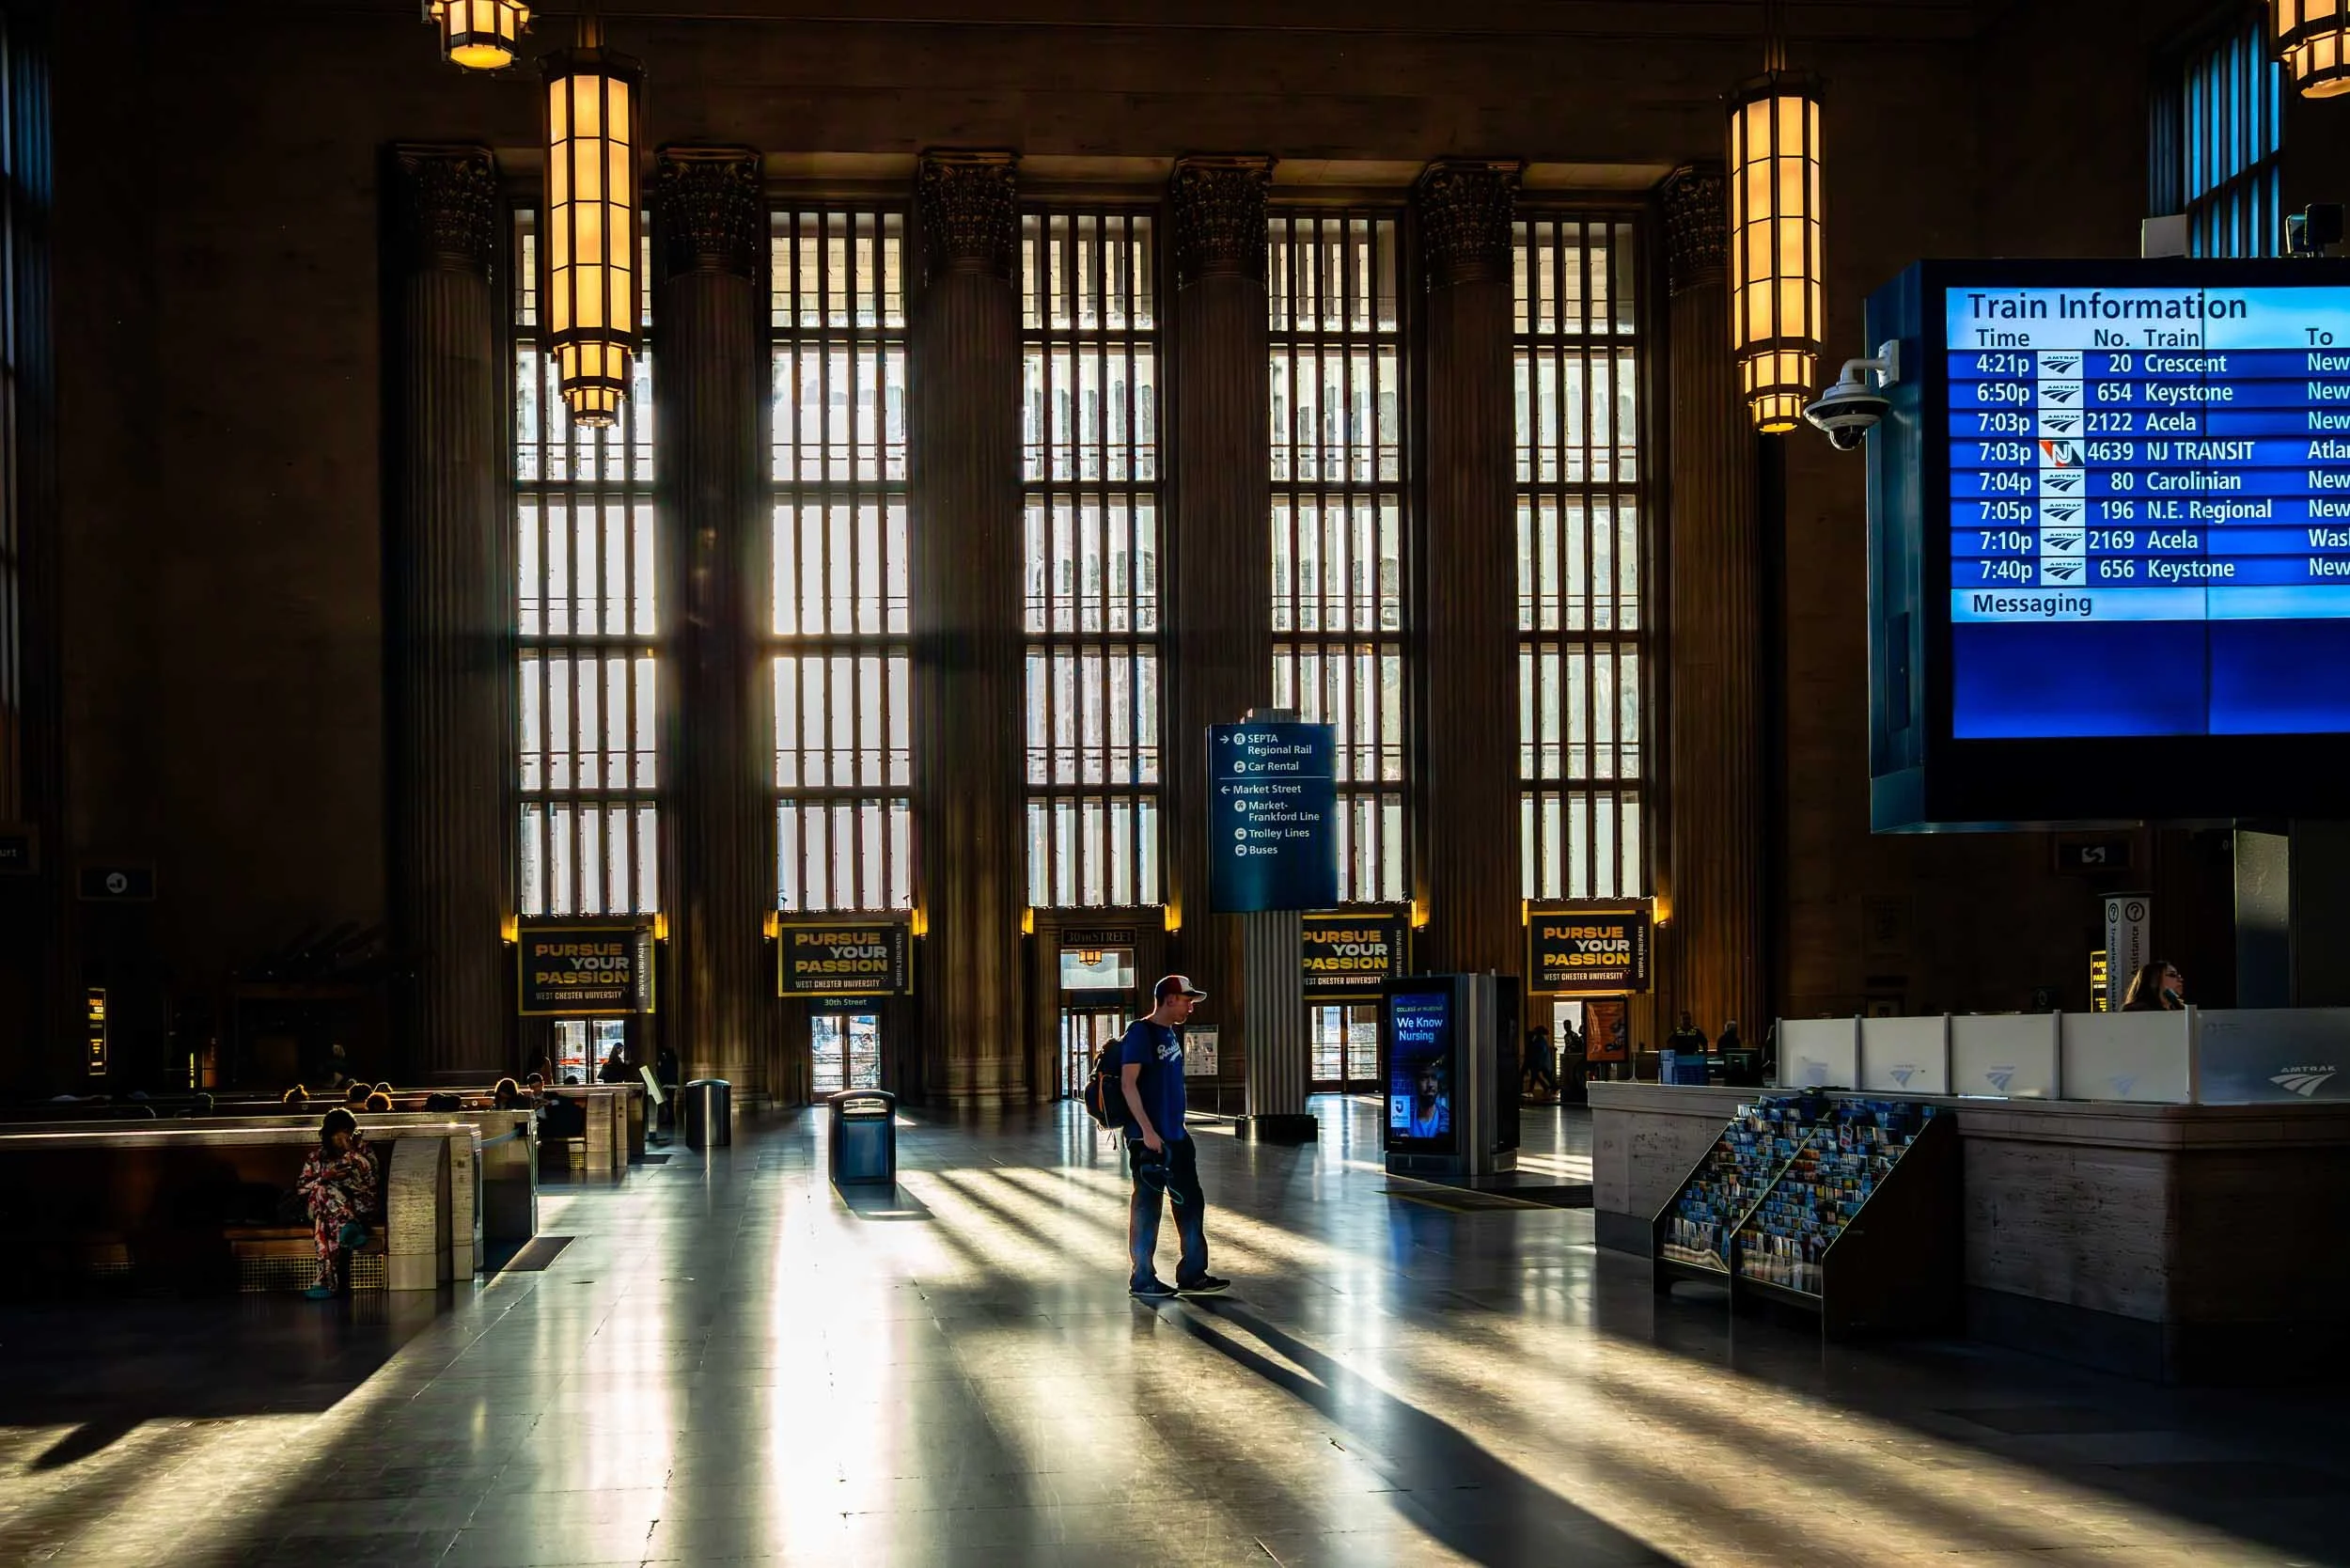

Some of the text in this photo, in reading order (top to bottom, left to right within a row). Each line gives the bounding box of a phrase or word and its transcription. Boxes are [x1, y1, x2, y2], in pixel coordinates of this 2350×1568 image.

[1967, 291, 2247, 319] Train Information
[1976, 327, 2334, 347] Time No. Train To
[1976, 353, 2350, 377] 4:21p 20 Crescent New
[1977, 382, 2350, 407] 6:50p 654 Keystone New
[1978, 411, 2350, 436] 7:03p 2122 Acela New
[1979, 442, 2031, 465] 7:03p
[2087, 442, 2134, 461] 4639
[2147, 442, 2169, 462] NJ
[2174, 441, 2255, 461] TRANSIT
[1980, 470, 2350, 495] 7:04p 80 Carolinian New
[1980, 499, 2350, 525] 7:05p 196 N.E. Regional New
[1980, 531, 2032, 555] 7:10p
[2089, 530, 2135, 549] 2169
[2147, 529, 2198, 549] Acela
[1980, 557, 2350, 584] 7:40p 656 Keystone New
[1973, 593, 2092, 616] Messaging
[1247, 734, 1278, 744] SEPTA
[1247, 745, 1311, 757] Regional Rail
[1248, 761, 1299, 771] Car Rental
[1233, 785, 1301, 794] Market Street
[1249, 801, 1288, 810] Market-
[1249, 812, 1320, 822] Frankford Line
[1248, 828, 1309, 839] Trolley Lines
[1249, 846, 1278, 855] Buses
[1302, 931, 1382, 943] PURSUE
[1543, 926, 1624, 939] PURSUE
[795, 933, 881, 946] PURSUE
[1574, 940, 1630, 952] YOUR
[535, 943, 622, 957] PURSUE
[828, 946, 887, 959] YOUR
[1332, 943, 1388, 956] YOUR
[570, 957, 630, 969] YOUR
[1302, 957, 1388, 970] PASSION
[1543, 952, 1631, 965] PASSION
[795, 960, 888, 972] PASSION
[535, 970, 630, 984] PASSION
[1561, 972, 1588, 980] CHESTER
[1589, 972, 1622, 980] UNIVERSITY
[814, 980, 842, 988] CHESTER
[536, 991, 622, 1000] WEST CHESTER UNIVERSITY
[1396, 1016, 1443, 1027] We Know
[1399, 1029, 1434, 1043] Nursing
[2280, 1065, 2336, 1074] AMTRAK
